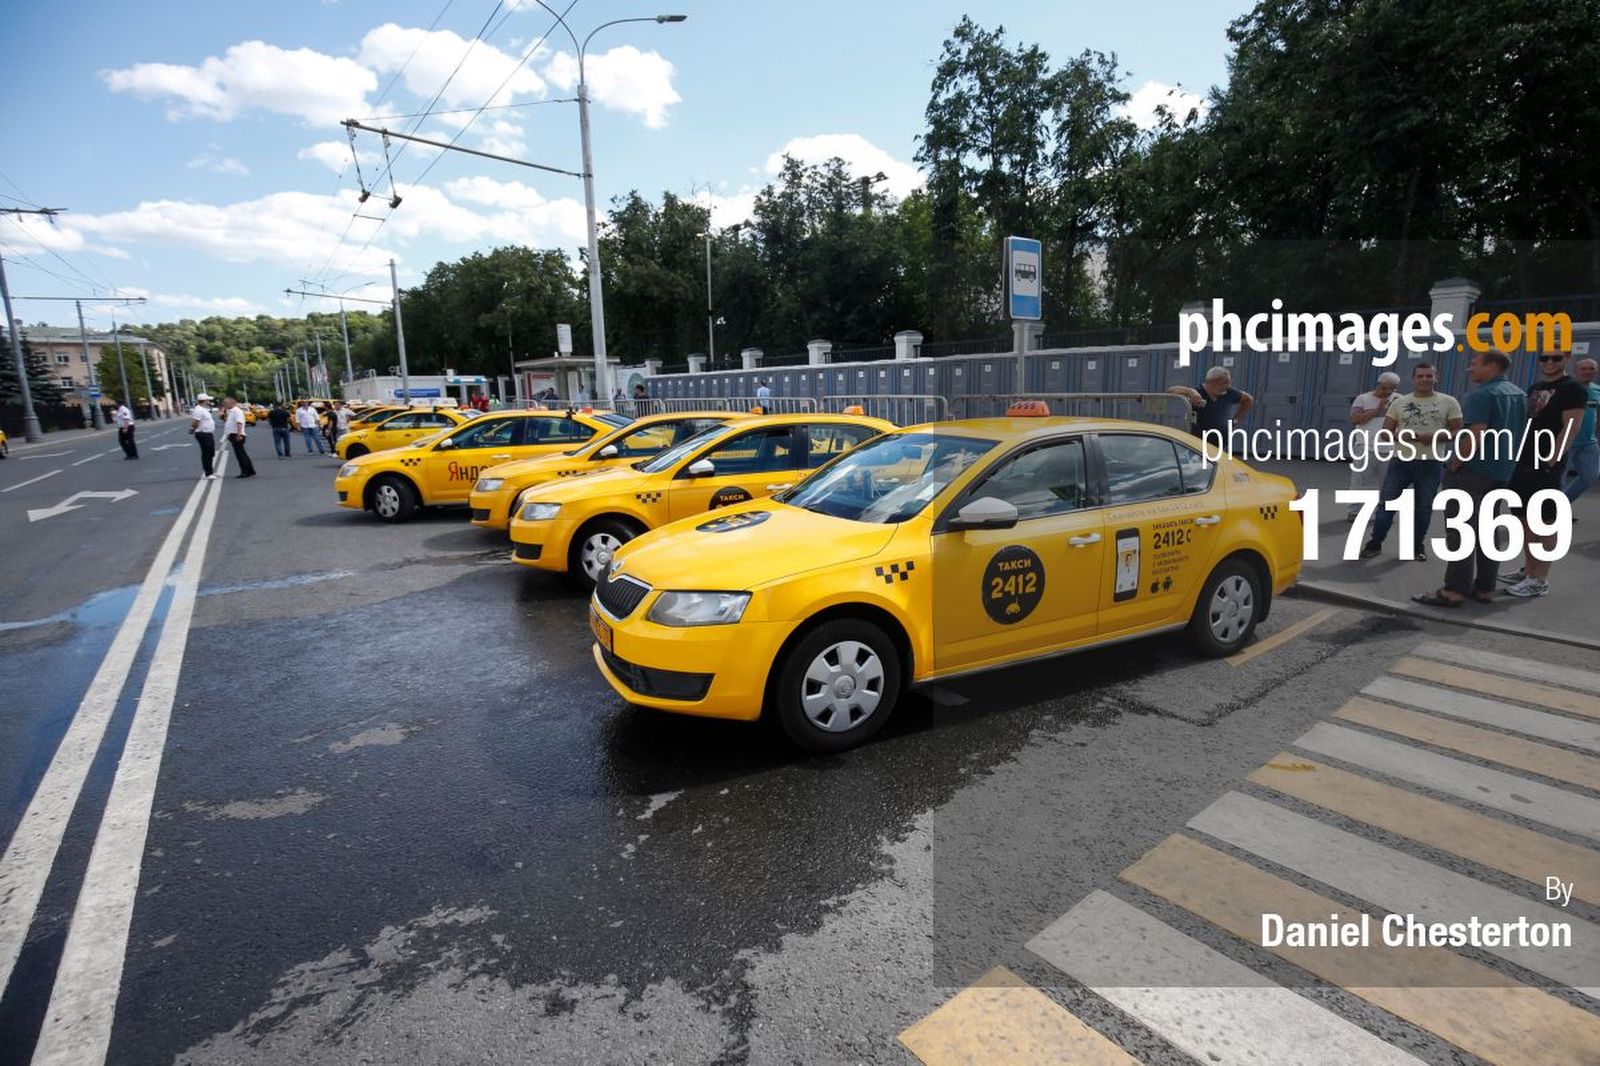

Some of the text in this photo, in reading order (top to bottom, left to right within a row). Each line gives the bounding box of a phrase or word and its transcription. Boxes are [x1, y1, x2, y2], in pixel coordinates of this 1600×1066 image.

[1153, 529, 1184, 549] 2412
[998, 558, 1032, 571] ТАКСИ
[991, 572, 1037, 599] 2412
